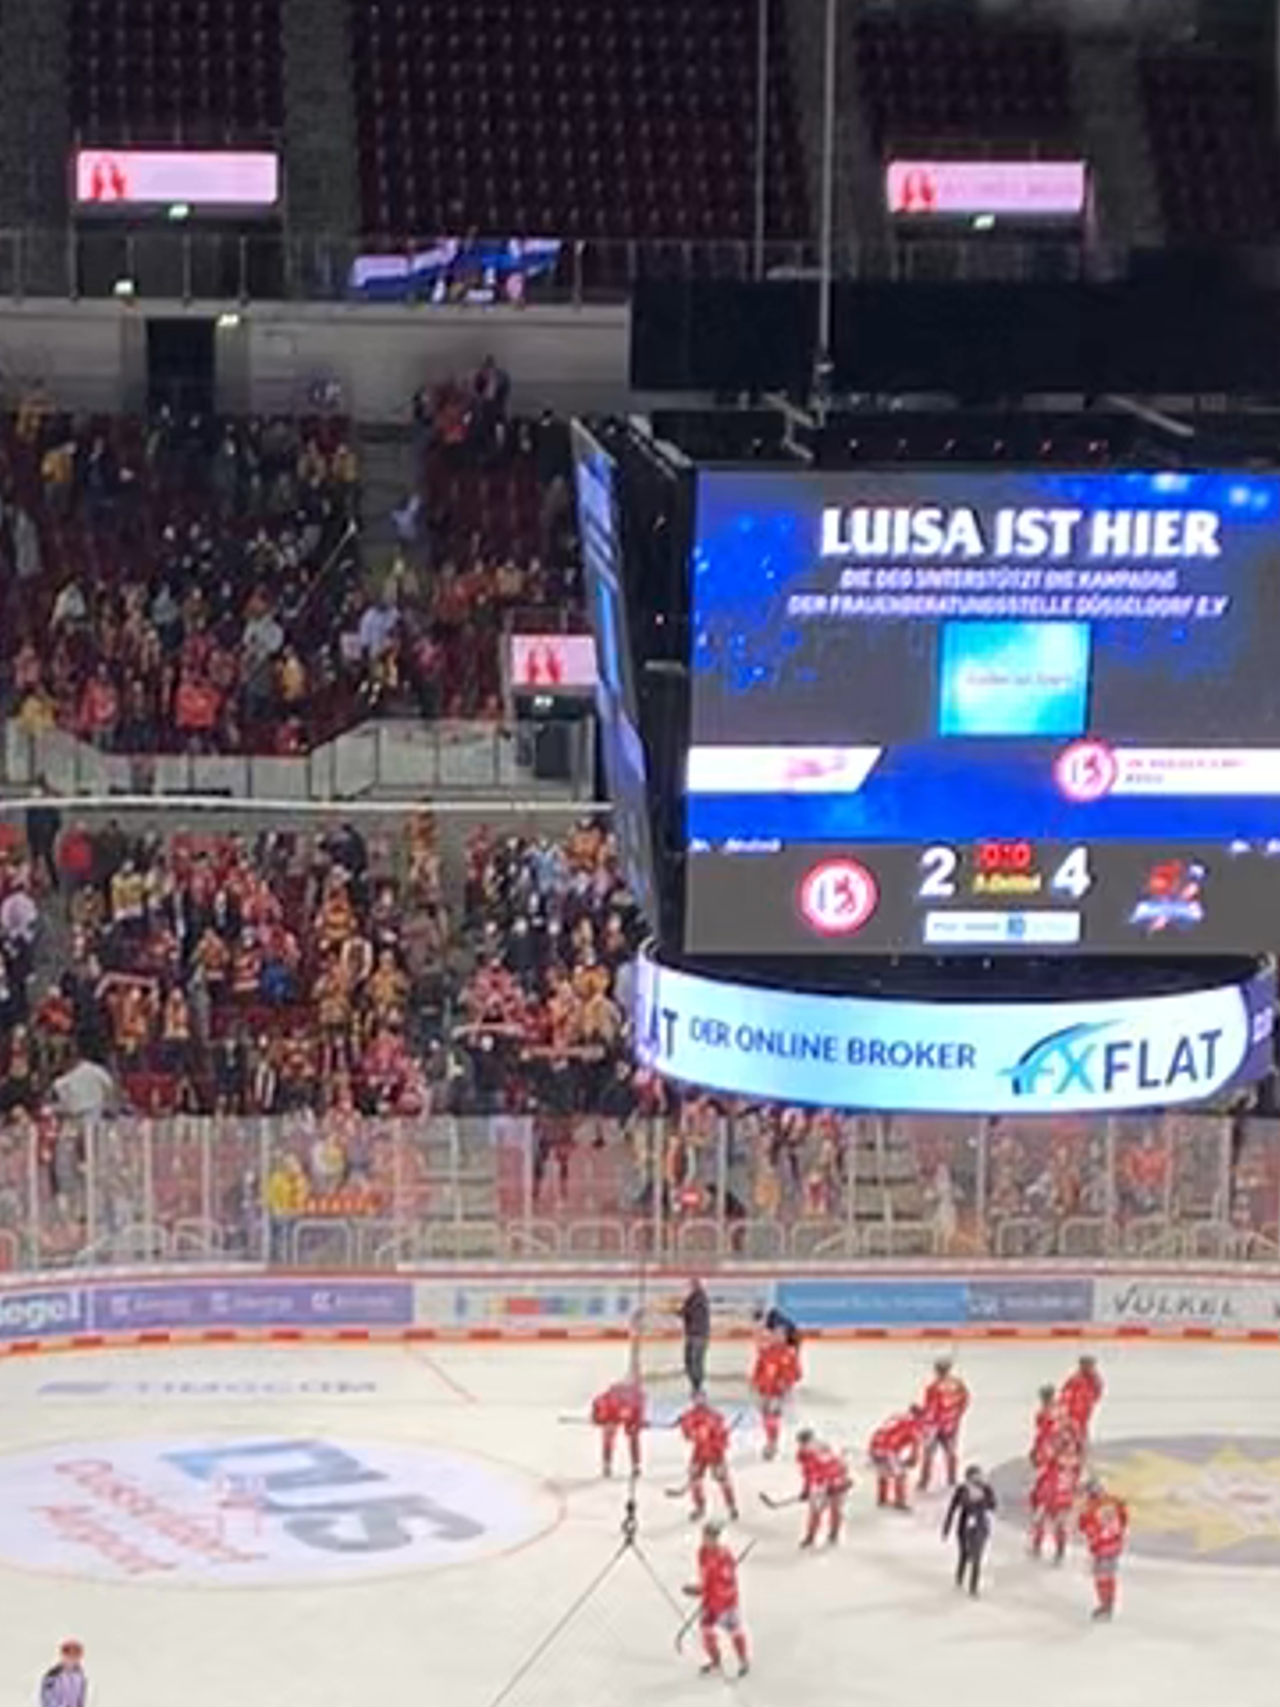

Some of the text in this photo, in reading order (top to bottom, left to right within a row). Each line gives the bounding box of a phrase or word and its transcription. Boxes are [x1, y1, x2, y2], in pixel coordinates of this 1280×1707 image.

[822, 508, 1221, 556] LUISA IST HIER
[919, 846, 957, 895] 2
[1052, 846, 1091, 896] 4
[689, 1017, 731, 1050] DER
[736, 1024, 838, 1063] ONLINE
[847, 1036, 976, 1071] BROKER
